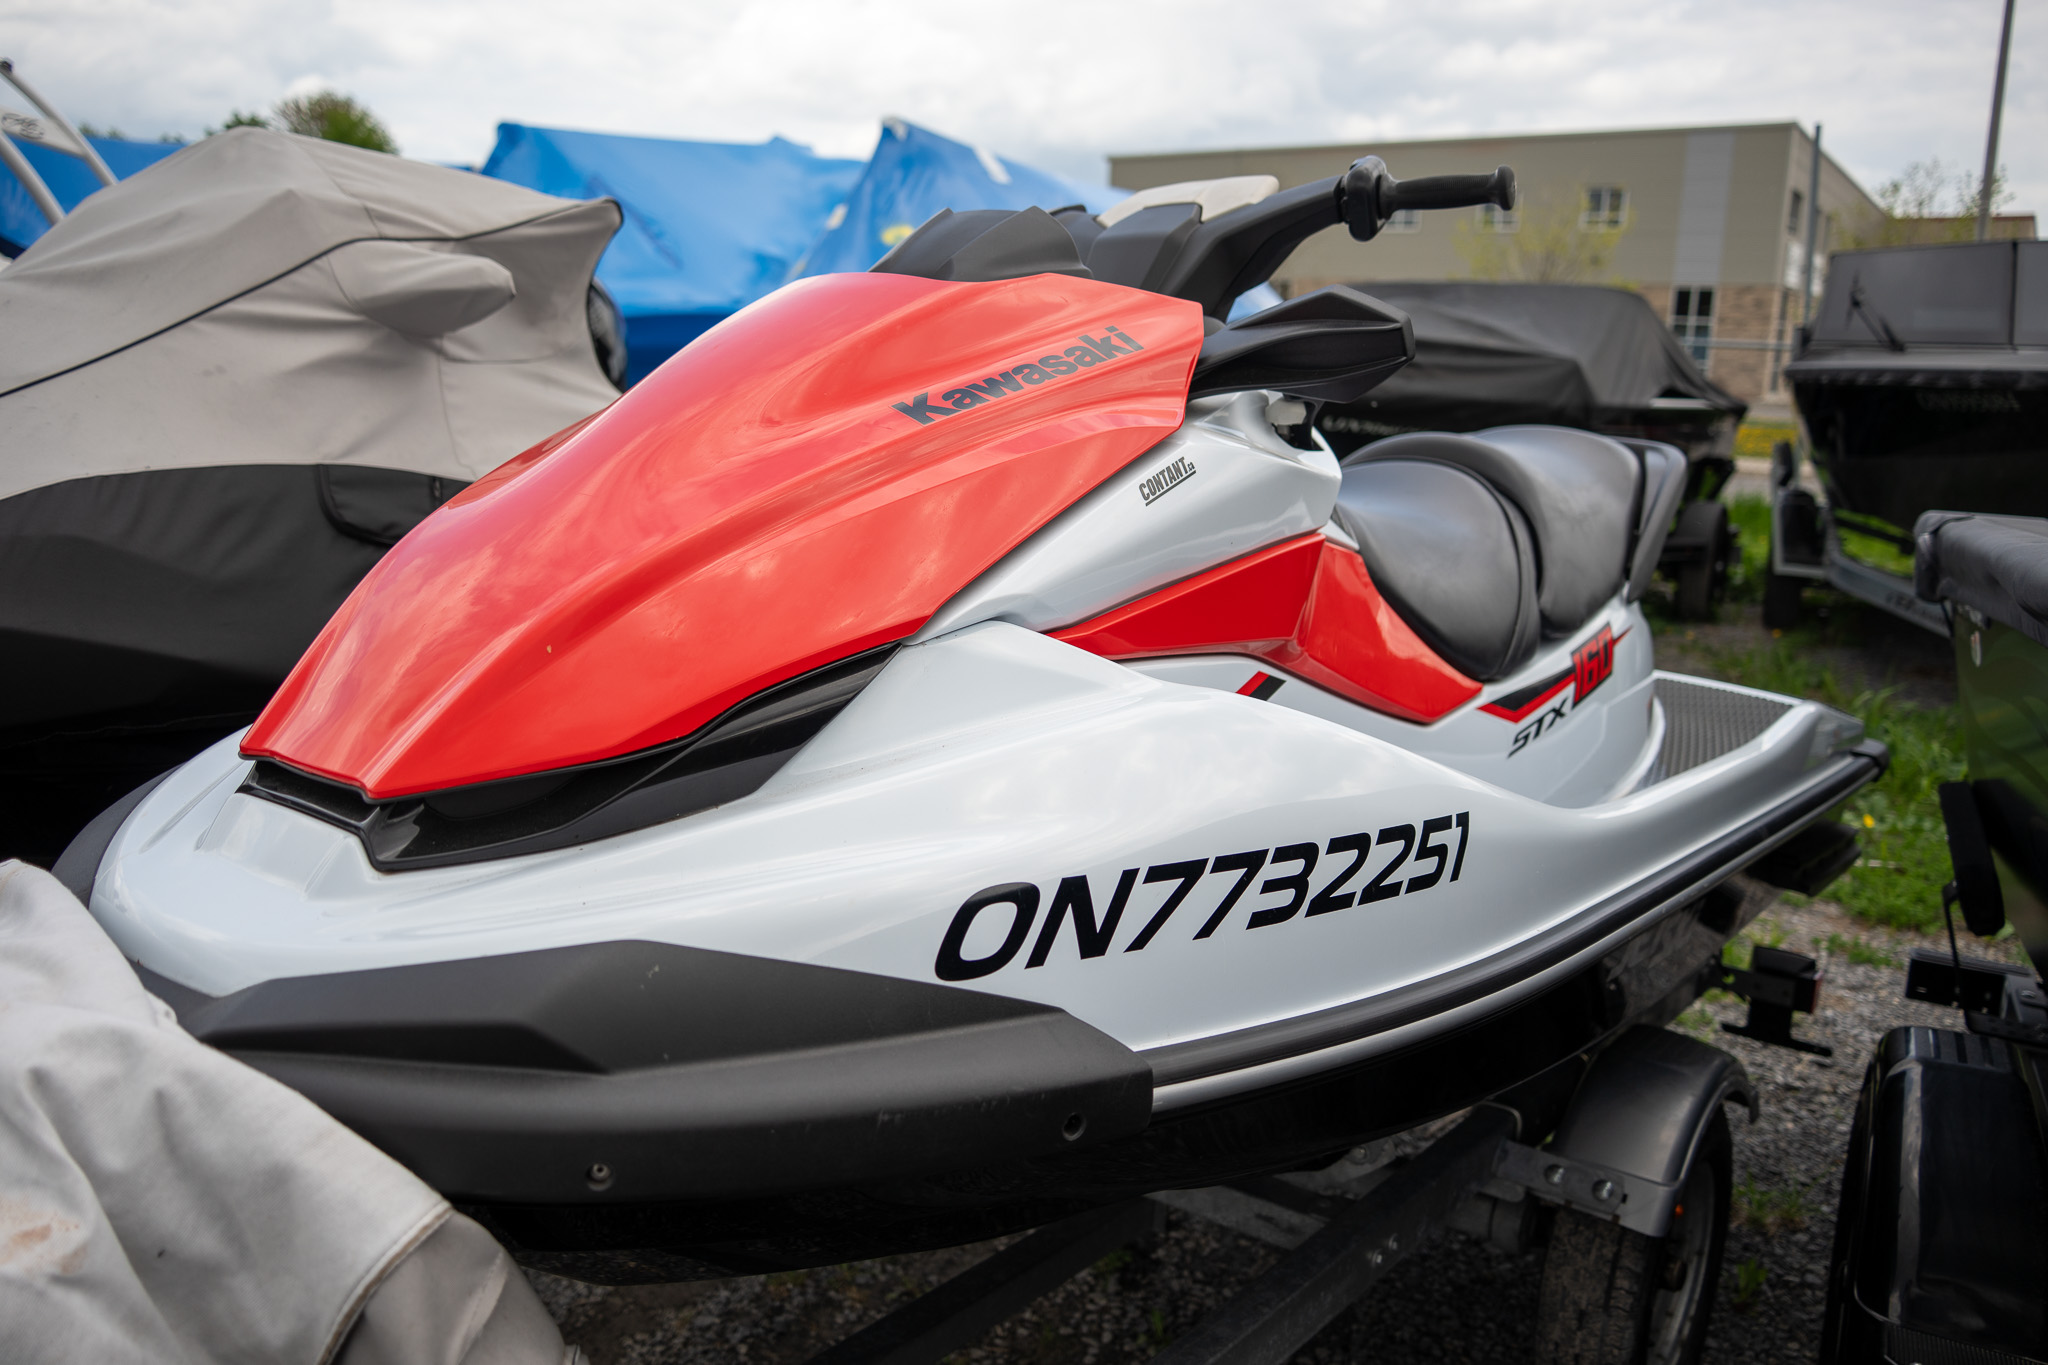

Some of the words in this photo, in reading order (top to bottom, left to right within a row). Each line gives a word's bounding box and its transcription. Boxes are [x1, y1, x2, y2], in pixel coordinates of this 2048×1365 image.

[891, 325, 1145, 426] Kawasaki
[1506, 696, 1569, 759] STX
[1571, 622, 1613, 707] 160
[934, 811, 1470, 982] ON7732251
